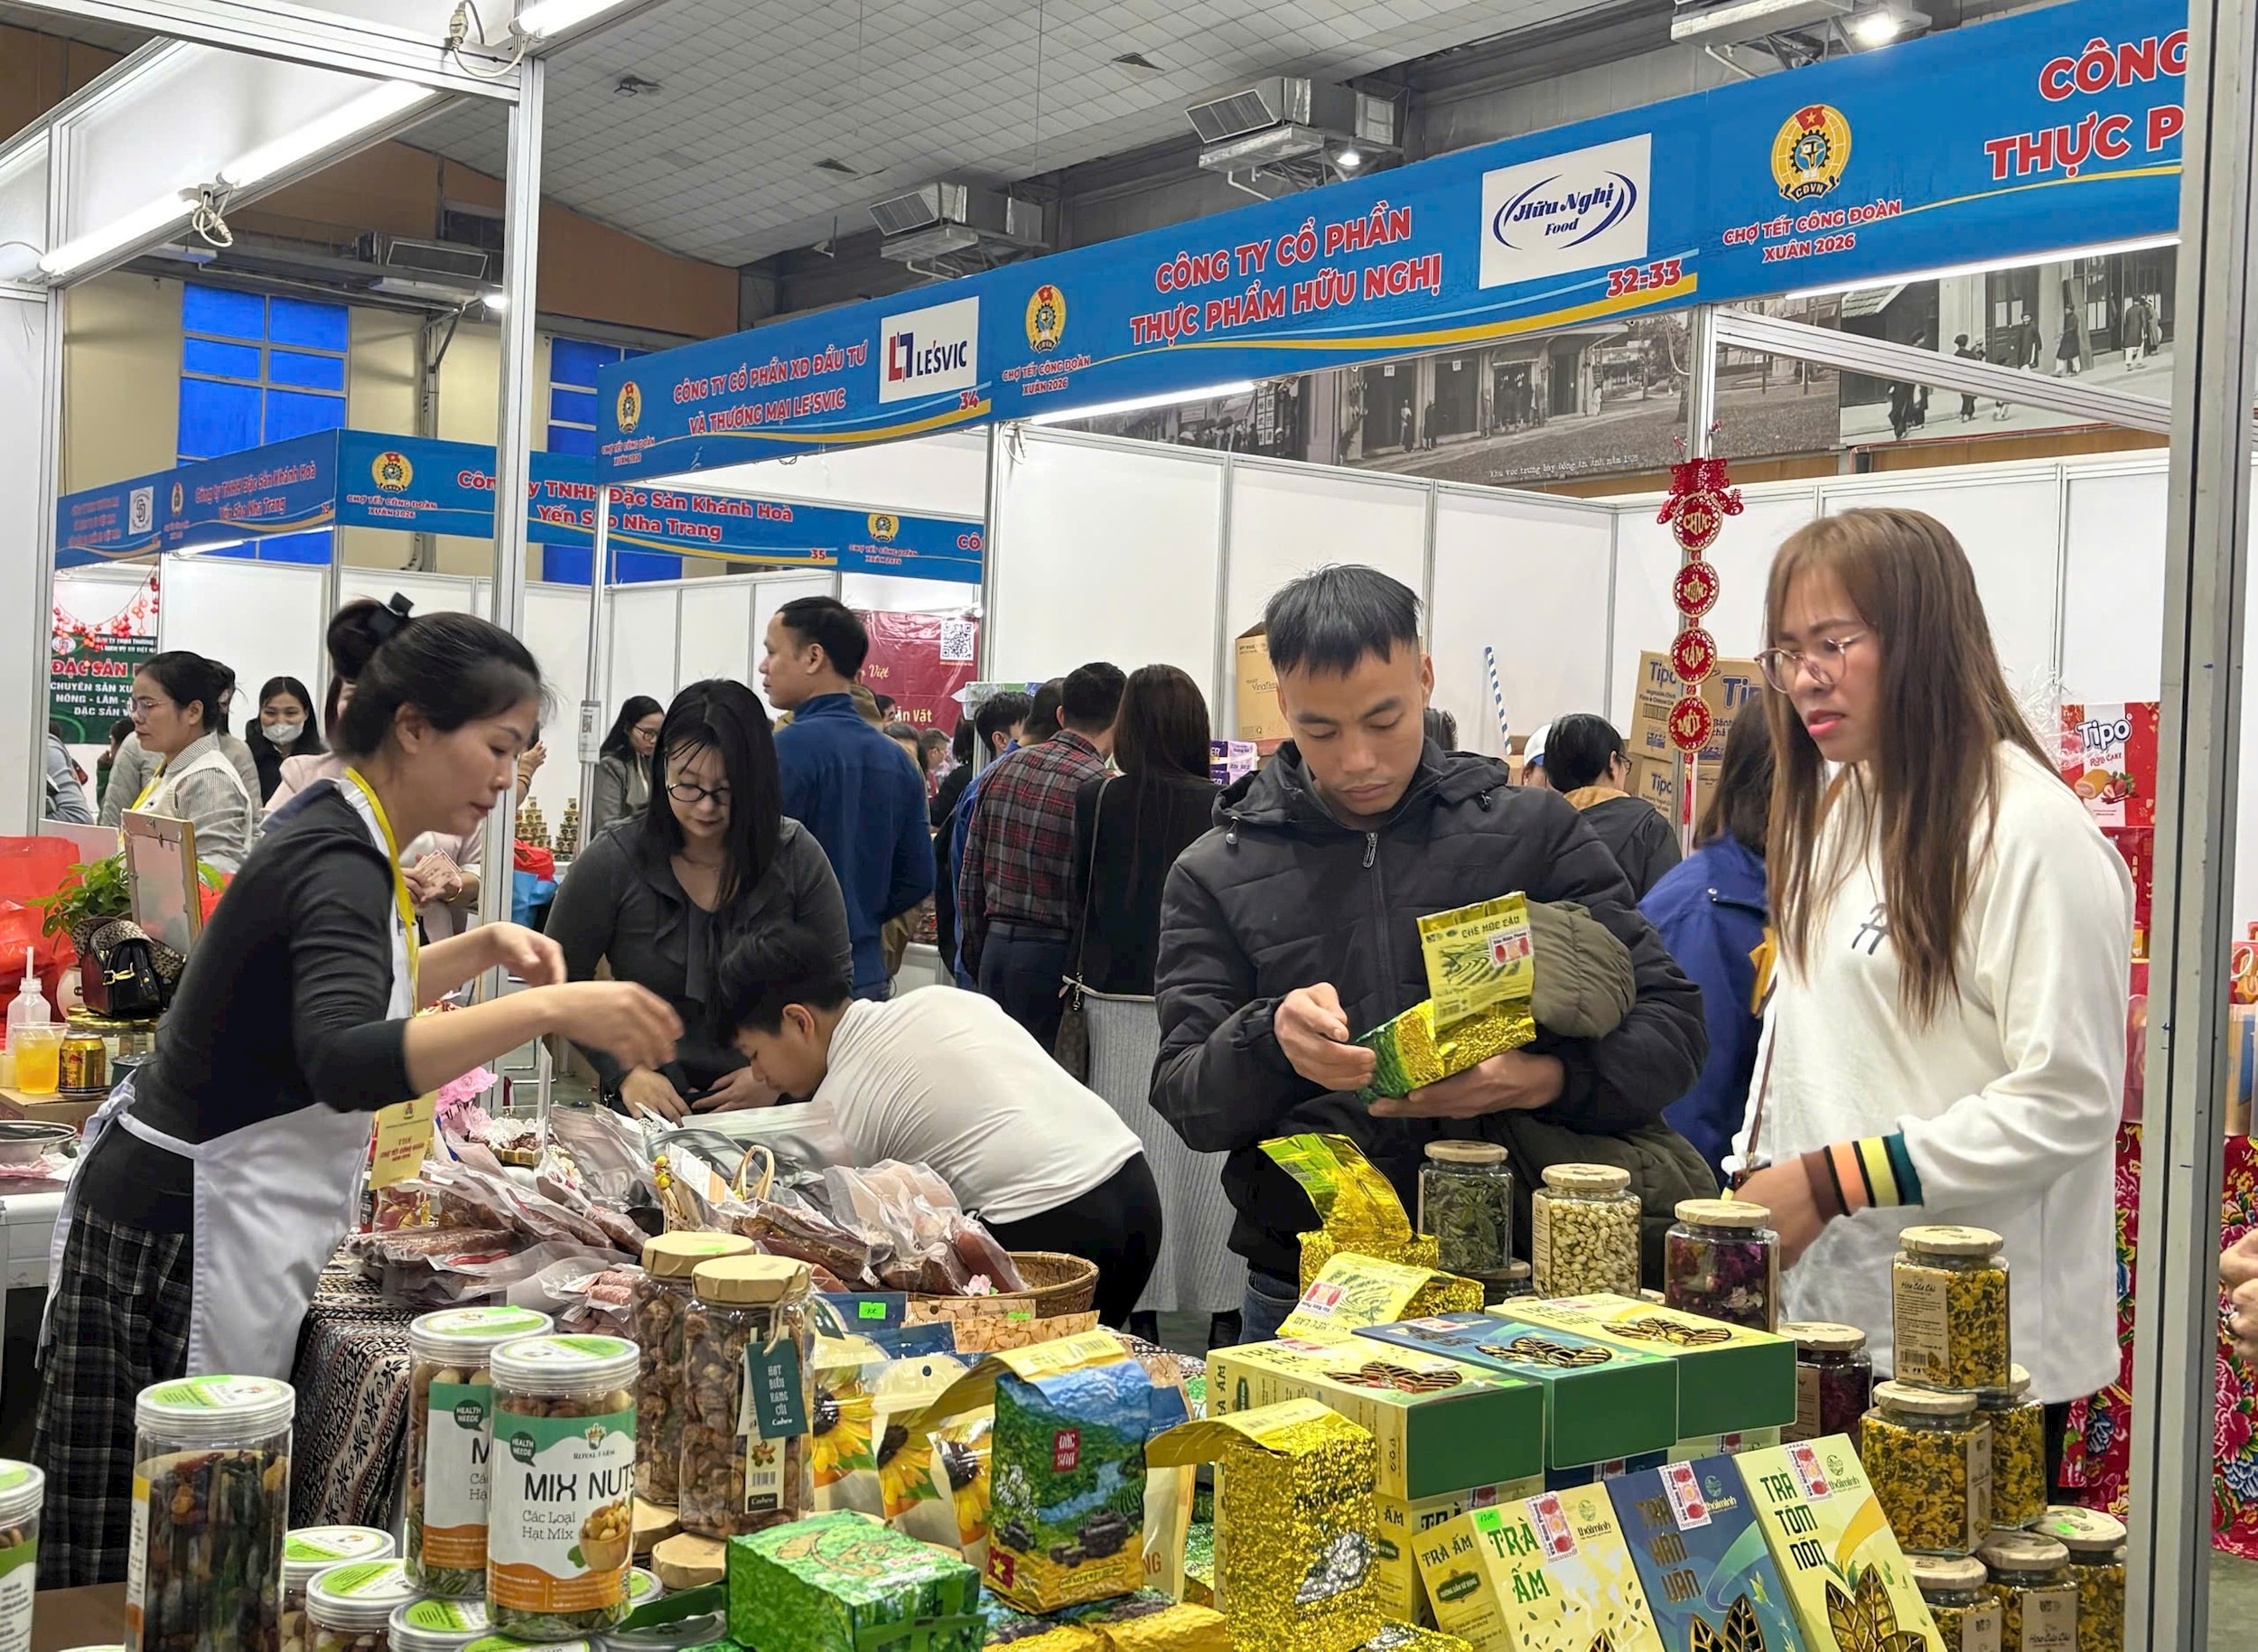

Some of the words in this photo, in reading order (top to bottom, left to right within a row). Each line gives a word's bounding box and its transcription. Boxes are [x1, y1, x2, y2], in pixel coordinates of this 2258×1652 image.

[1984, 111, 2132, 181] THỰC
[1513, 199, 1559, 223] Hữu
[1560, 182, 1614, 217] Nghị
[1544, 218, 1580, 237] Food
[1723, 221, 1760, 246] CHỢ
[1761, 215, 1793, 238] TẾT
[1796, 210, 1845, 232] CÔNG
[1848, 198, 1902, 223] ĐOÀN
[1155, 251, 1229, 293] CÔNG
[1234, 239, 1271, 275] TY
[1275, 217, 1317, 266] CỔ
[1324, 200, 1411, 257] PHẦN
[1762, 238, 1812, 264] XUÂN
[1815, 232, 1856, 255] 2026
[1606, 257, 1682, 298] 32-33
[1130, 302, 1199, 347] THỰC
[1204, 279, 1285, 331] PHẨM
[1292, 266, 1356, 315] HỮU
[1363, 253, 1442, 301] NGHỊ
[673, 378, 708, 405] CÔNG
[711, 373, 727, 397] TY
[728, 362, 748, 392] CỔ
[750, 355, 788, 387] PHẦN
[789, 358, 811, 380] XD
[813, 344, 844, 375] ĐẦU
[845, 338, 868, 367] TƯ
[1002, 366, 1022, 382] CHỢ
[1022, 360, 1038, 378] TẾT
[1038, 359, 1064, 376] CÔNG
[1064, 353, 1091, 371] ĐOÀN
[959, 388, 980, 411] 34
[1022, 379, 1047, 397] XUÂN
[1047, 377, 1069, 391] 2026
[688, 410, 707, 434] VÀ
[709, 403, 763, 434] THƯƠNG
[765, 402, 792, 426] MẠI
[458, 471, 496, 491] Côn
[609, 488, 647, 509] Đặc
[651, 490, 687, 512] Sản
[691, 494, 753, 519] Khánh
[757, 502, 794, 522] Hoà
[537, 503, 575, 524] Yến
[582, 511, 618, 530] So
[623, 514, 662, 533] Nha
[664, 517, 723, 543] Trang
[1683, 507, 1712, 536] CHÚC
[810, 547, 826, 560] 35
[956, 532, 983, 552] CÔ
[91, 658, 128, 677] SẢN
[869, 663, 890, 680] Việt
[56, 694, 87, 704] NÔNG
[2075, 719, 2132, 751] Tipo
[456, 1406, 482, 1416] HEALTH
[772, 1416, 793, 1426] Cashew
[511, 1437, 535, 1449] HEALTH
[470, 1473, 489, 1486] Cá
[524, 1472, 578, 1502] MIX
[588, 1461, 635, 1500] NUTS
[1759, 1467, 1798, 1502] TRÀ
[470, 1489, 488, 1502] Hạ
[522, 1510, 546, 1524] Các
[548, 1510, 575, 1526] Loại
[1774, 1505, 1818, 1536] TÔM
[522, 1526, 545, 1542] Hạt
[547, 1527, 574, 1541] Mix
[1488, 1517, 1541, 1559] TRÀ
[1422, 1543, 1450, 1567] TRÀ
[1451, 1533, 1473, 1555] ẤM
[1789, 1536, 1828, 1571] NÕN
[1512, 1563, 1551, 1603] ẤM
